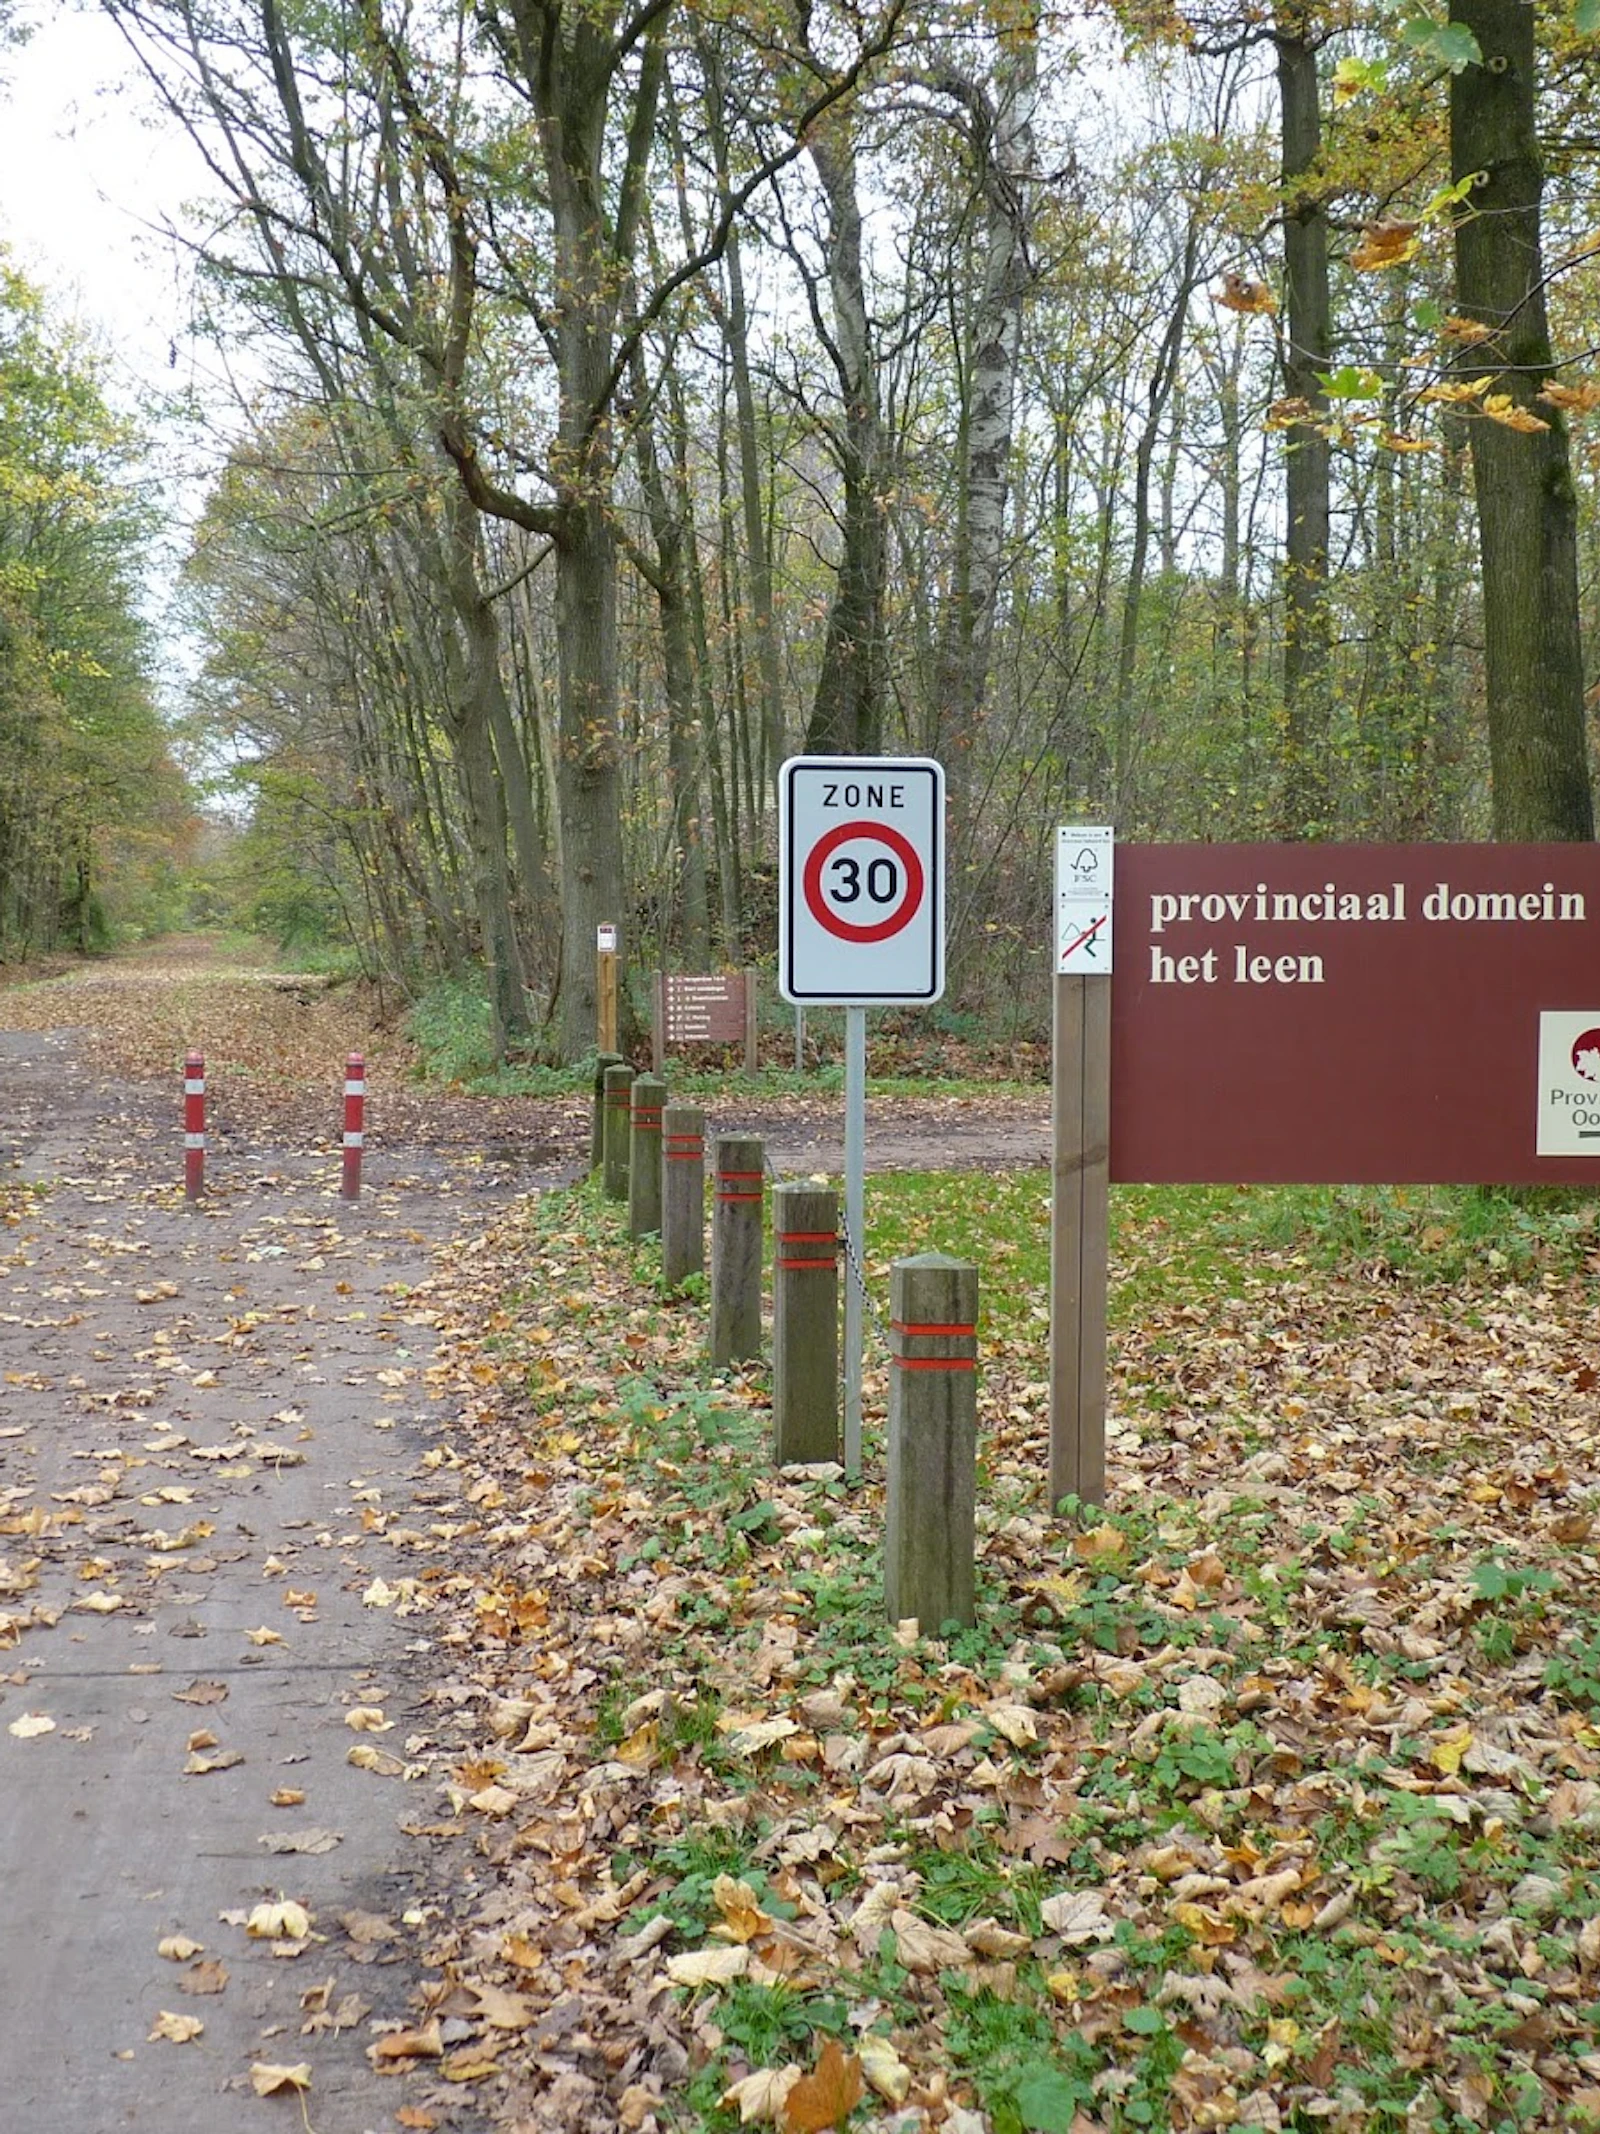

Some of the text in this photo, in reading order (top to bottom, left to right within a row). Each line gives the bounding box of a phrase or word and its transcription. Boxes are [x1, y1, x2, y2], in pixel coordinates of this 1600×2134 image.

[823, 785, 905, 808] ZONE
[830, 858, 897, 904] 30
[1074, 874, 1097, 883] FSC
[1150, 883, 1587, 933] provinciaal domein
[1149, 945, 1325, 984] het leen
[1551, 1089, 1600, 1106] Prov
